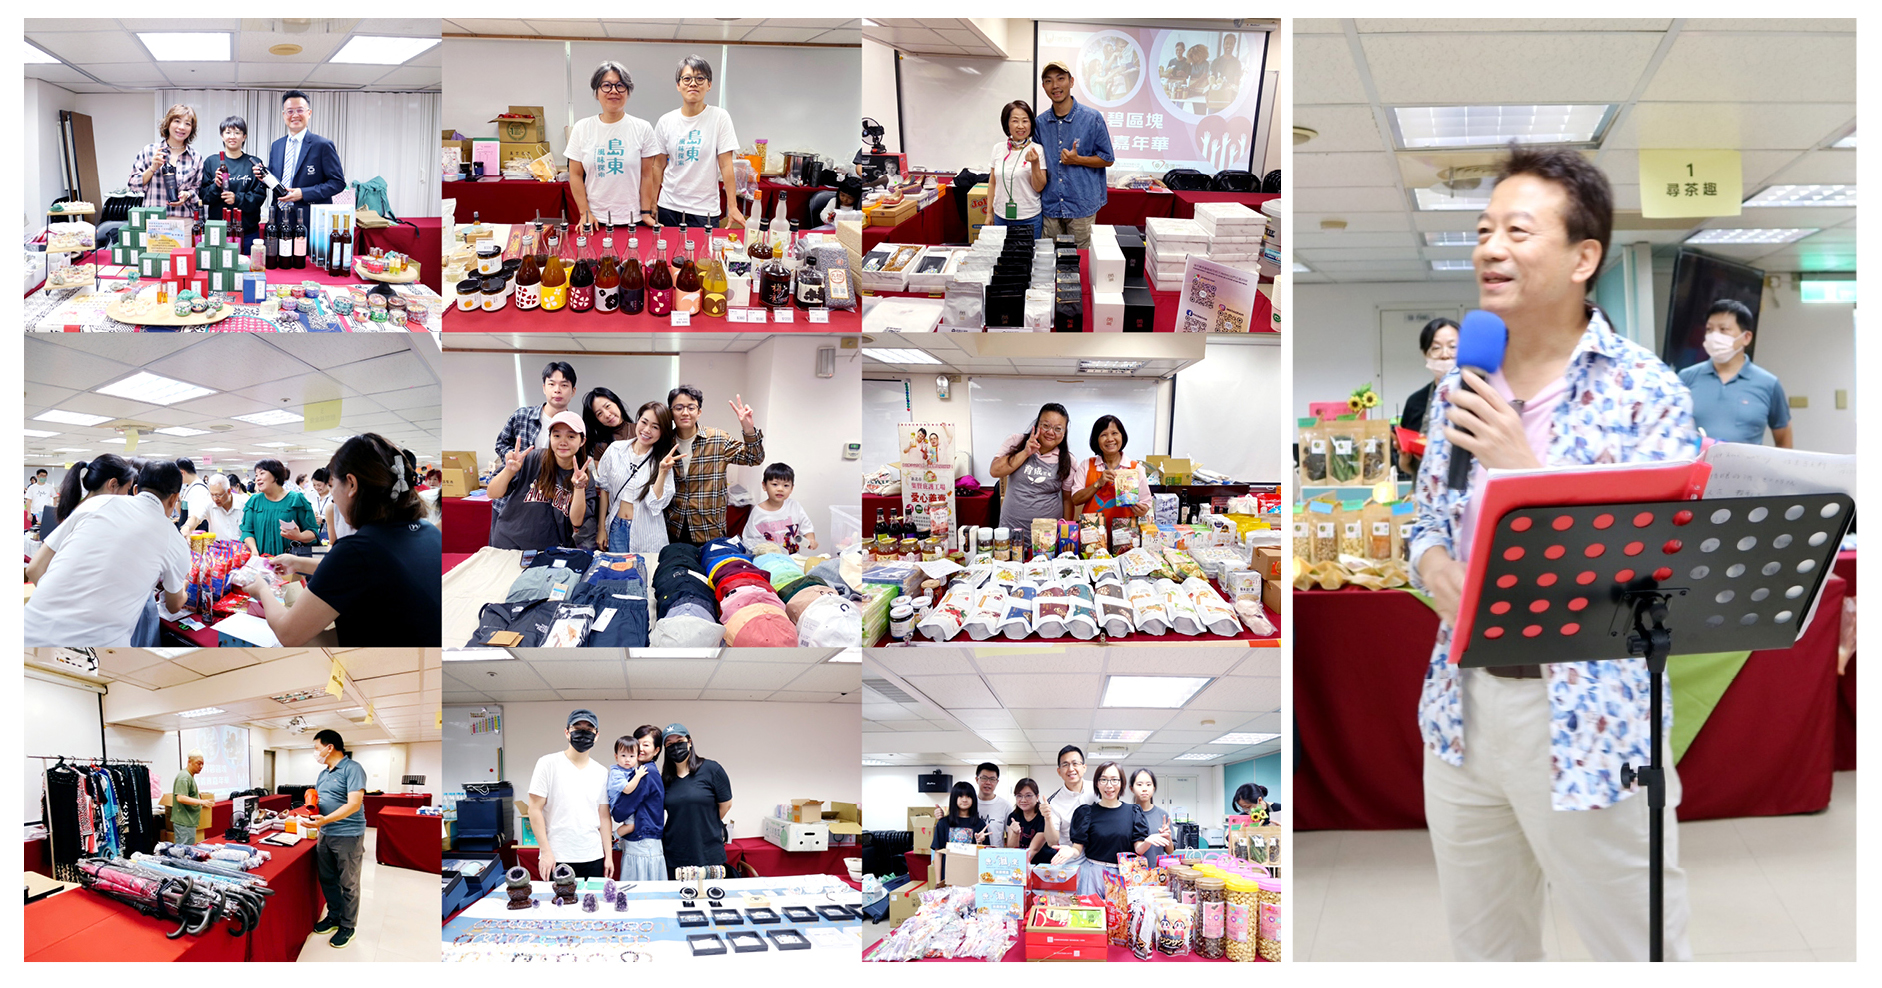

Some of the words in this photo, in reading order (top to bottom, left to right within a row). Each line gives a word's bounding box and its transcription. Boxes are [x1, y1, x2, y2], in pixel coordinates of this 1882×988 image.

[606, 138, 625, 175] 島東
[685, 129, 702, 162] 島東
[1686, 163, 1694, 177] 1
[1666, 182, 1717, 197] 尋茶趣
